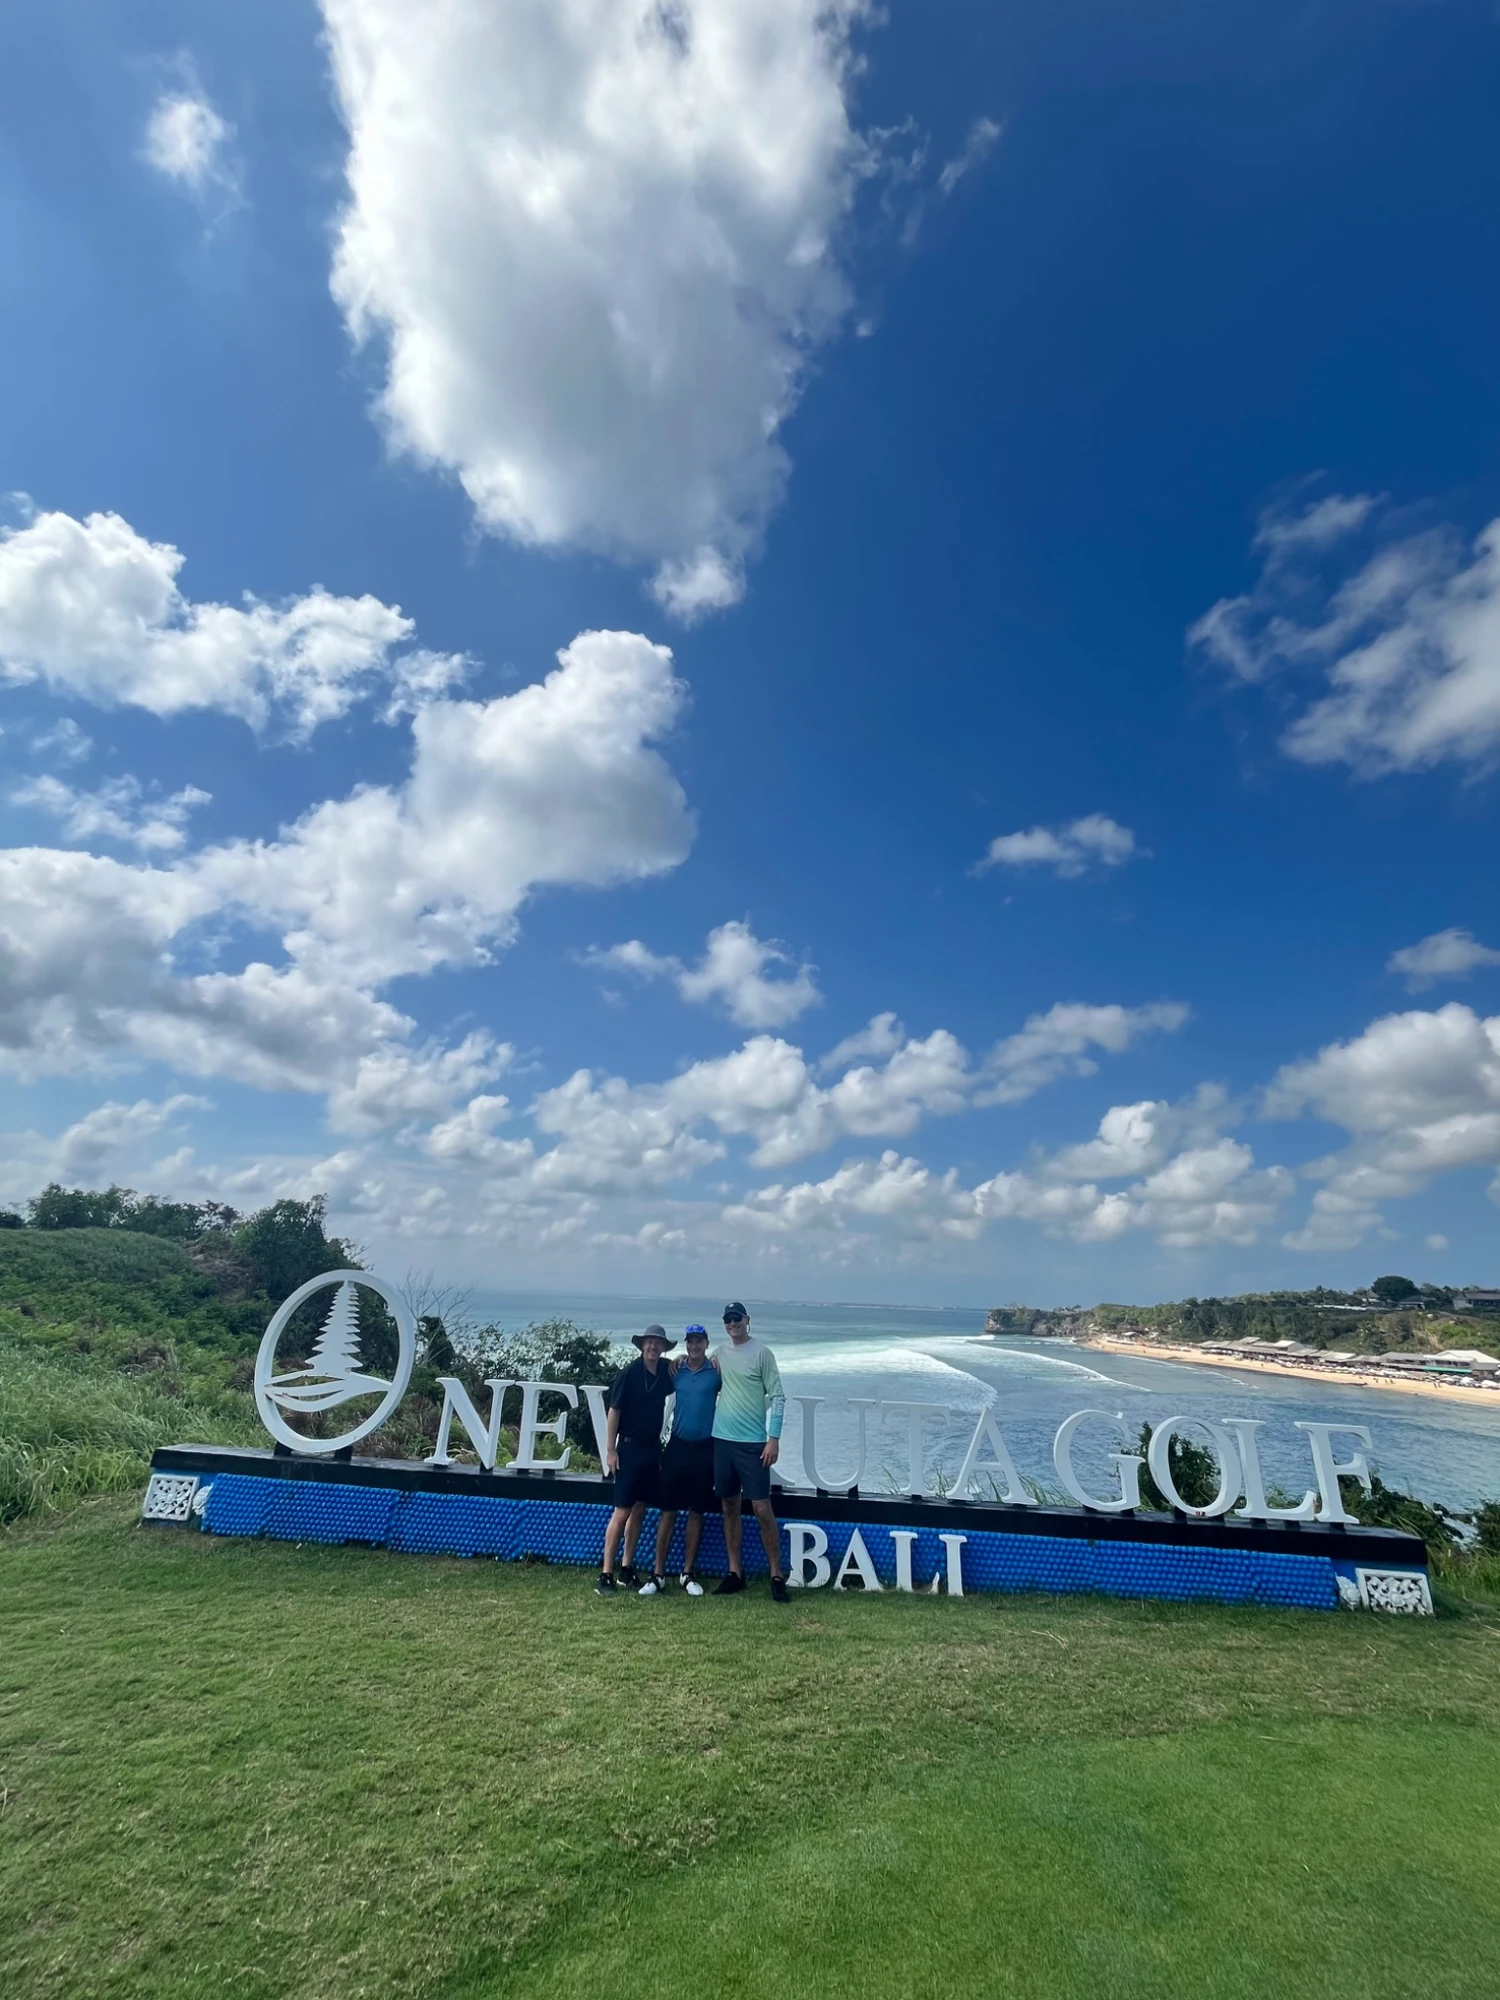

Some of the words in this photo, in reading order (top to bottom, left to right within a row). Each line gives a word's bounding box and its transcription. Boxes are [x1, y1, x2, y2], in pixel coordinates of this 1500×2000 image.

[766, 1396, 1038, 1505] UTA
[1053, 1409, 1373, 1524] GOLF
[783, 1523, 967, 1597] BALI
